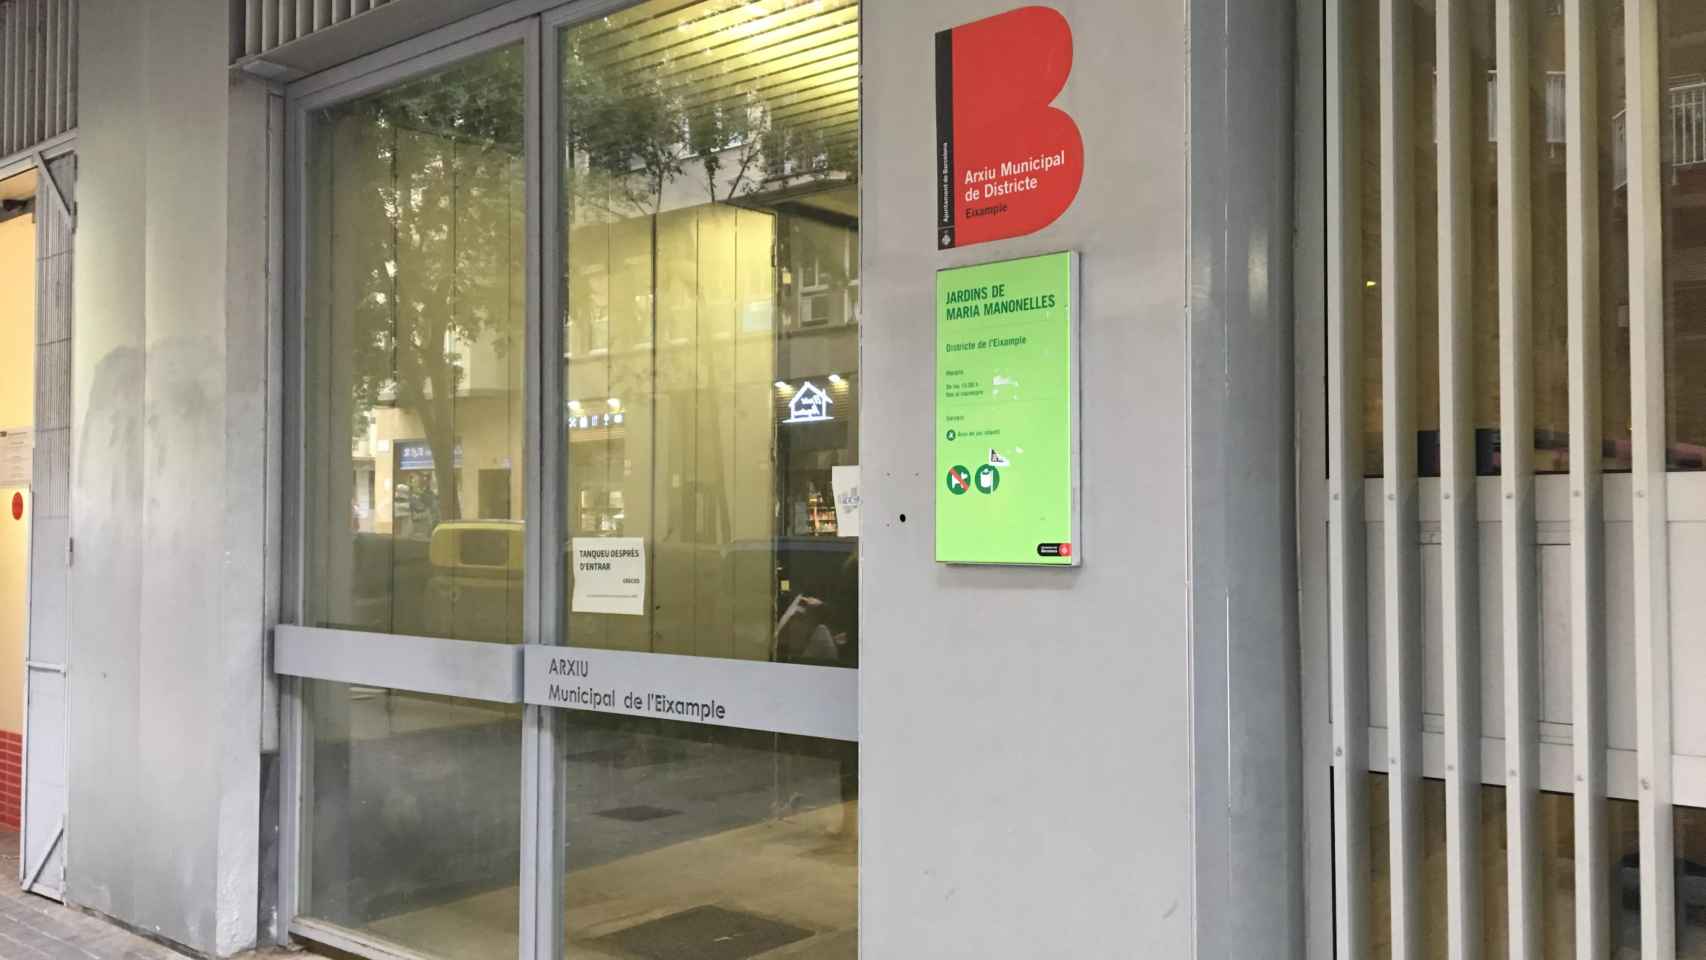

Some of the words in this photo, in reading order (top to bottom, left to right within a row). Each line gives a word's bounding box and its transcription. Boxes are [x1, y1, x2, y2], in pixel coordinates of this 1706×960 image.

[964, 166, 996, 185] Arxiu
[1000, 150, 1065, 177] Municipal
[965, 187, 980, 202] de
[984, 176, 1038, 198] Districte
[966, 204, 1008, 219] Eixample
[946, 287, 988, 304] JARDINS
[992, 284, 1005, 298] DE
[946, 306, 980, 320] MARIA
[984, 294, 1056, 316] MANONELLES
[946, 342, 976, 352] Districte
[978, 340, 987, 349] de
[988, 336, 1026, 348] l'Eixample
[580, 550, 610, 560] TANQUEU
[610, 548, 640, 558] DESPRÉS
[580, 562, 610, 571] D'ENTRAR
[548, 658, 588, 678] ARXIU
[548, 684, 615, 708] Municipal
[624, 691, 642, 710] de
[648, 693, 726, 721] l'Eixample
